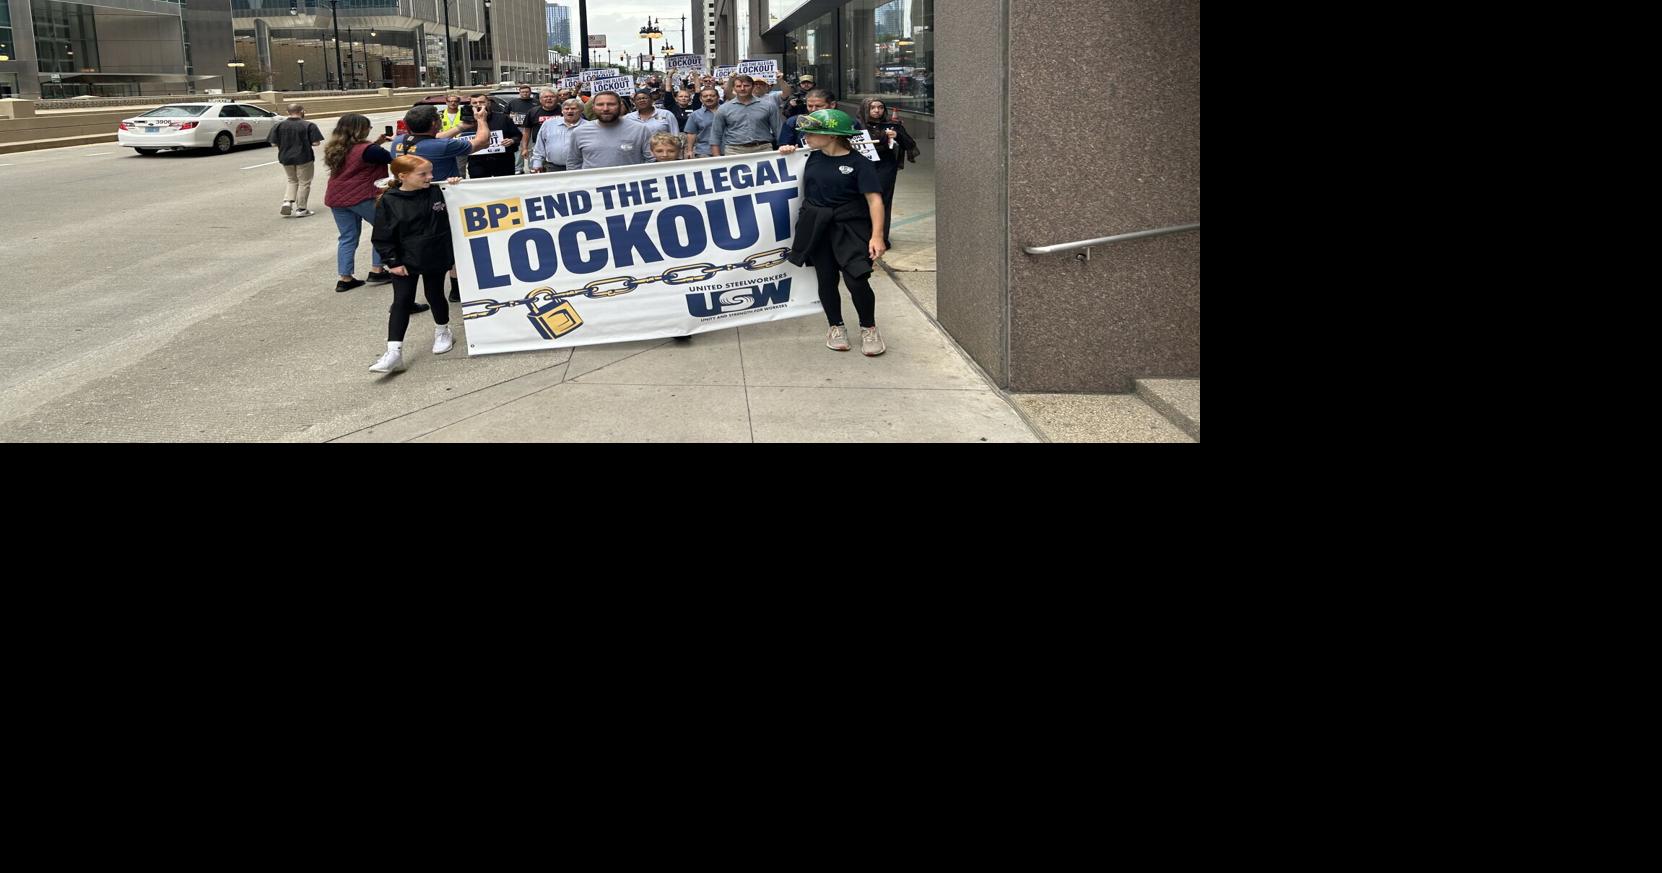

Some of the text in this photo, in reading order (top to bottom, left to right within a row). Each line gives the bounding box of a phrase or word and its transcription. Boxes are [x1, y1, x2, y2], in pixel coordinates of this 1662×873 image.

[668, 58, 701, 68] LOCKOUT
[738, 65, 774, 74] LOCKOUT
[594, 80, 630, 92] LOCKOUT
[464, 158, 797, 232] BP: END THE ILLEGAL
[469, 187, 798, 290] LOCKOUT
[689, 272, 788, 292] UNITED STEELWORKERS
[686, 277, 792, 318] USW
